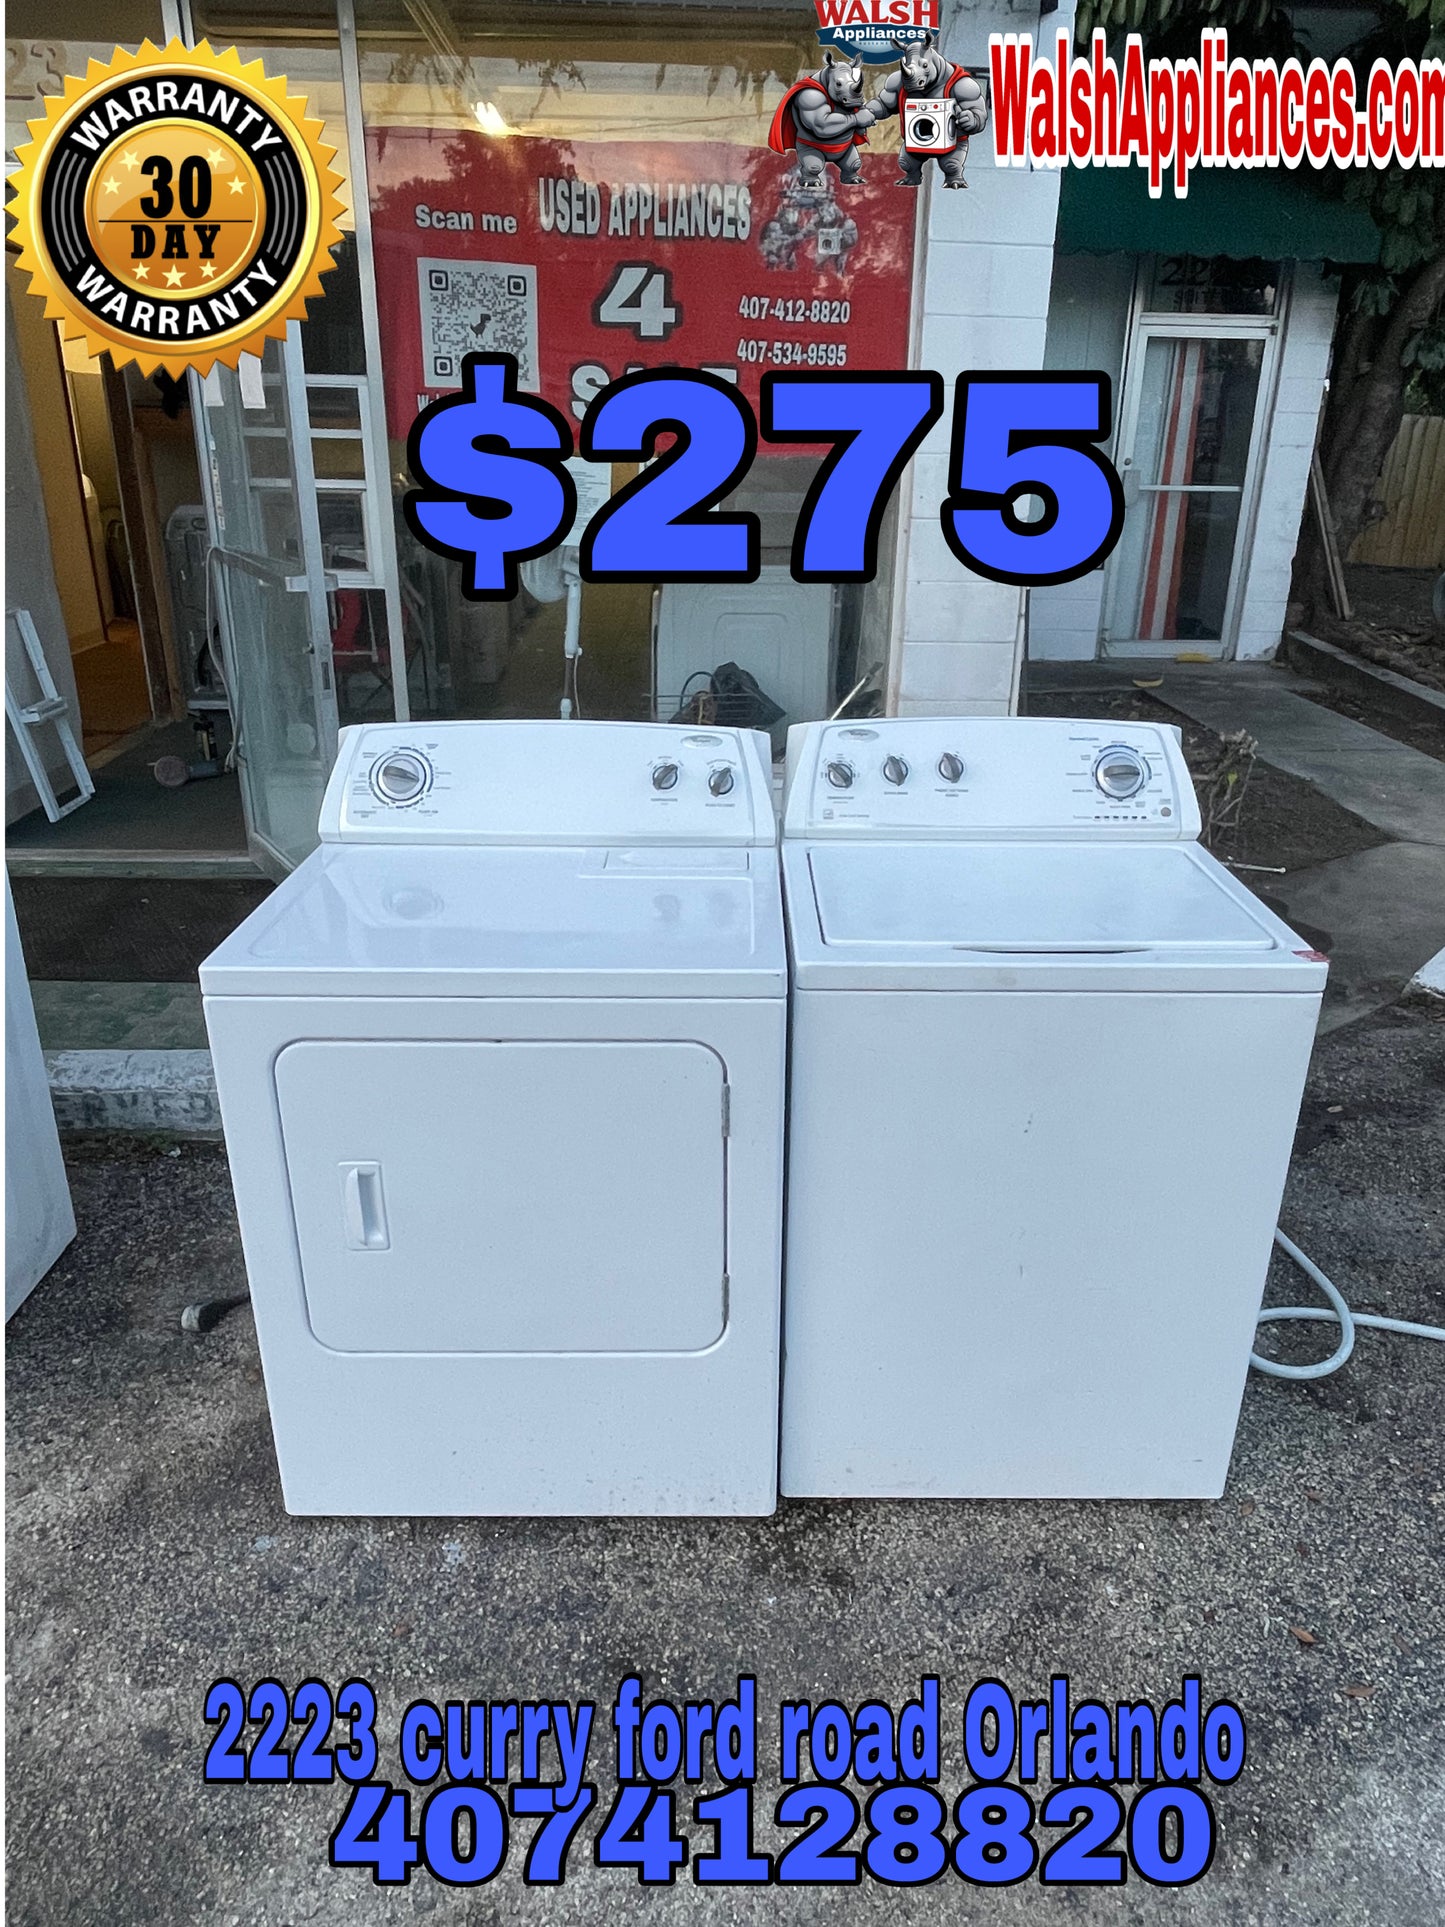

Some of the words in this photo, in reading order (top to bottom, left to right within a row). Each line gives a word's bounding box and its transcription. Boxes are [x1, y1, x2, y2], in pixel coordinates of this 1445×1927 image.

[415, 203, 475, 231] Scan
[481, 212, 518, 234] me
[538, 176, 600, 236] USED
[607, 182, 752, 241] APPLIANCES
[598, 265, 678, 338] 4
[738, 294, 851, 324] 407-412-8820
[736, 337, 847, 367] 407-534-9595
